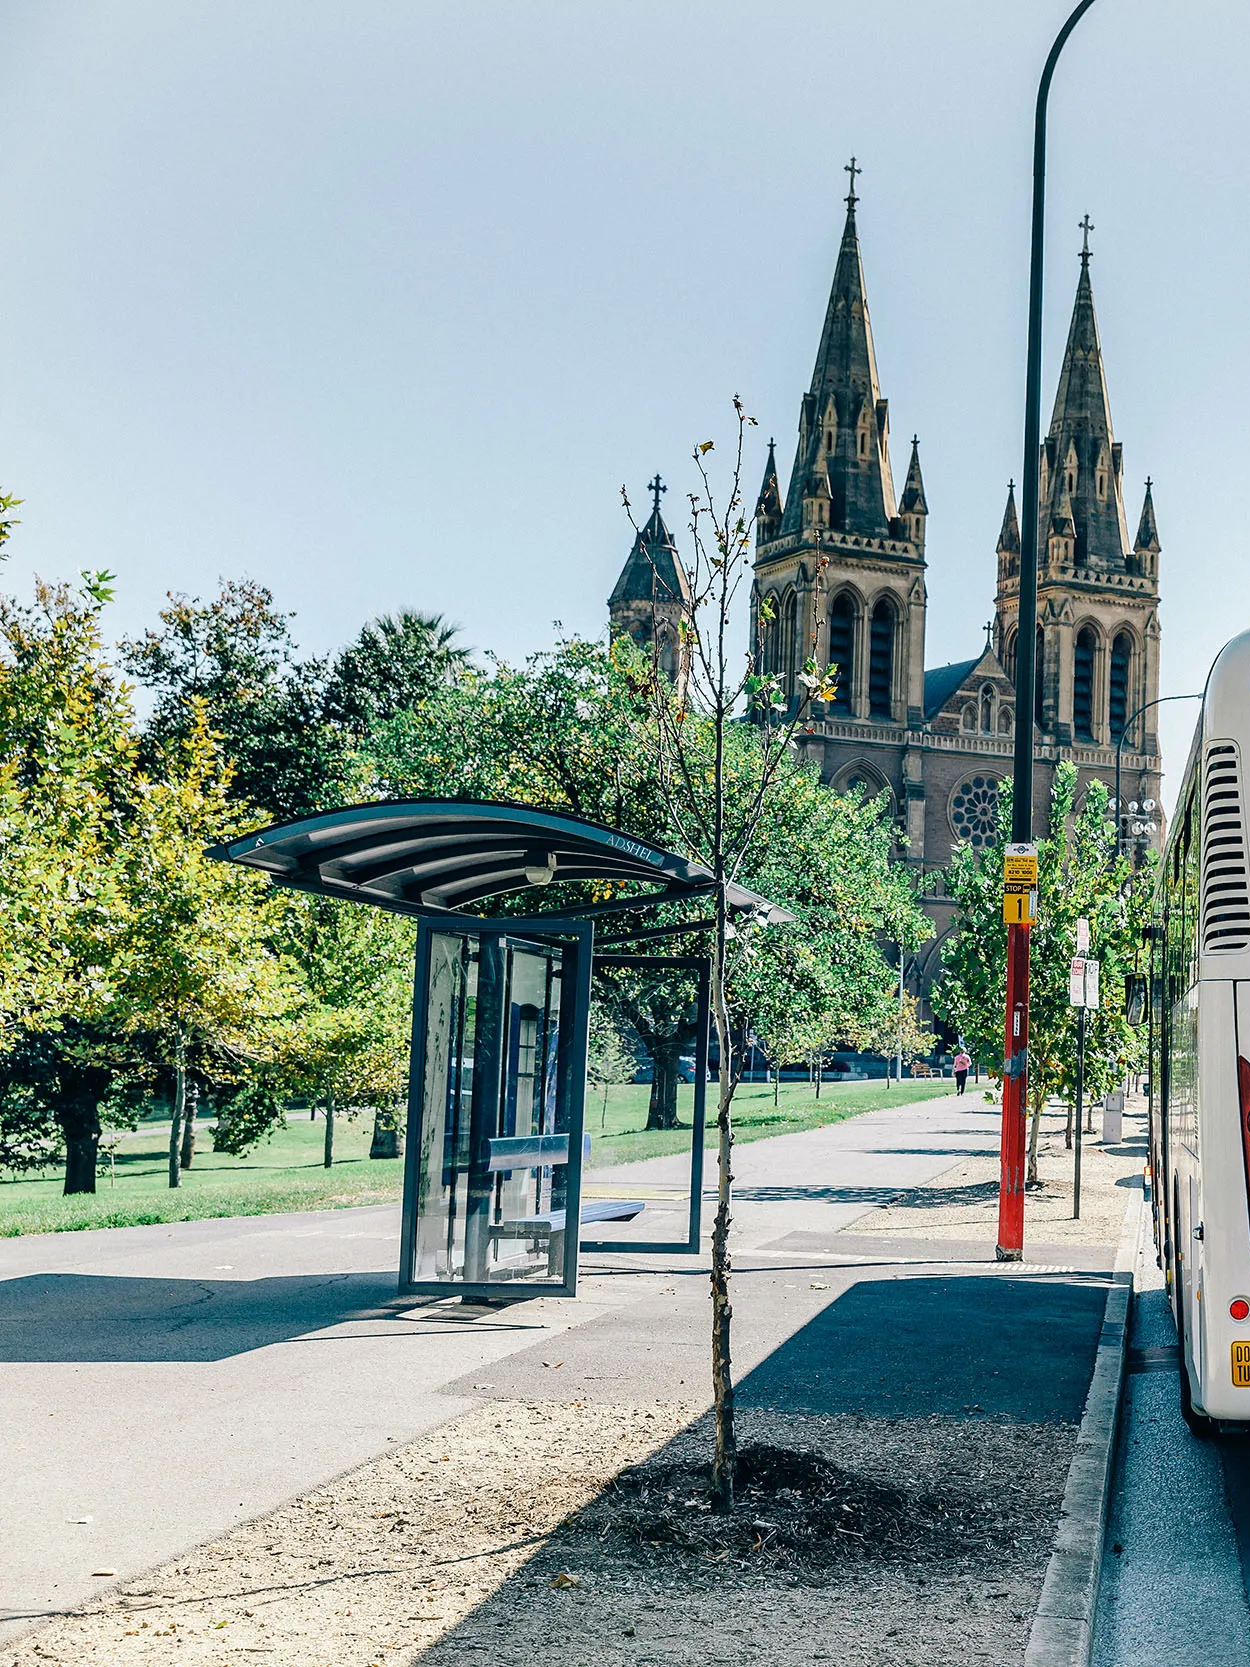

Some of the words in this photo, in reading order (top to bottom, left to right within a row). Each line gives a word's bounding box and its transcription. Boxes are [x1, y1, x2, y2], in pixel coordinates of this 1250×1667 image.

[606, 835, 652, 861] ADSHEL
[1017, 898, 1022, 921] 1
[1236, 1345, 1250, 1362] DO
